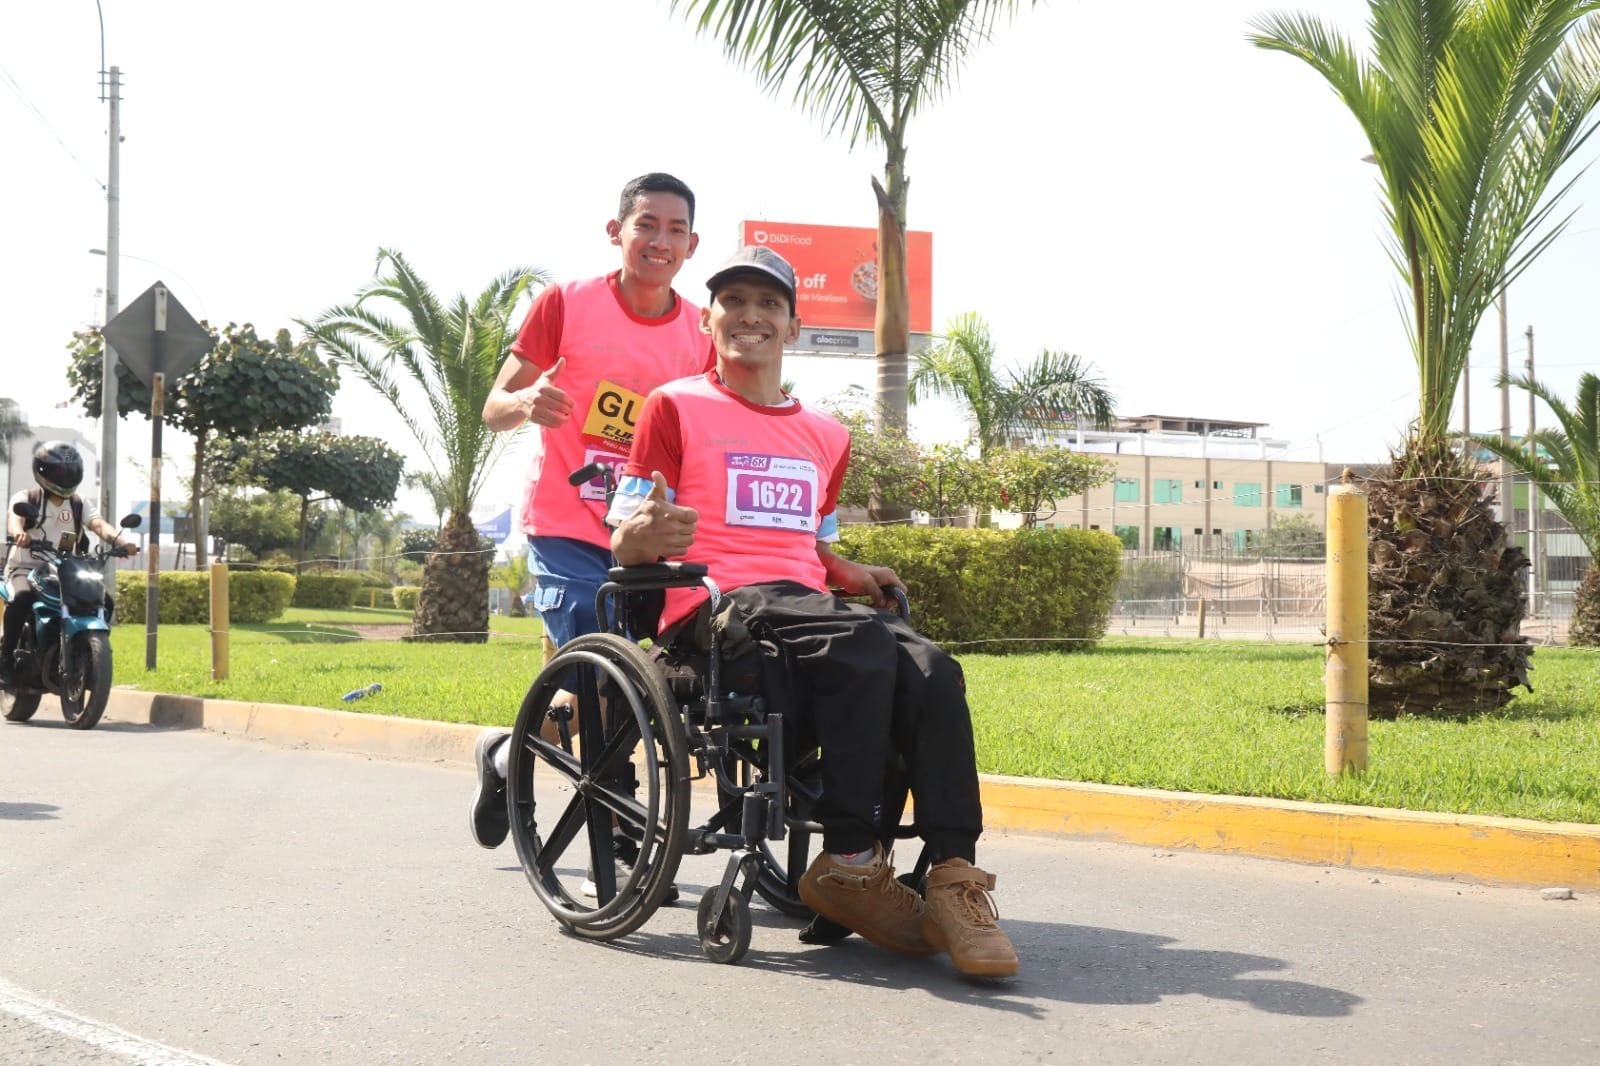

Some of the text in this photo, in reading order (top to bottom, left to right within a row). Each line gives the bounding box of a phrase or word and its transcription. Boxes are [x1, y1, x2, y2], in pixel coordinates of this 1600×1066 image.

[803, 273, 827, 289] off
[751, 457, 767, 467] 6K
[748, 480, 803, 512] 1622
